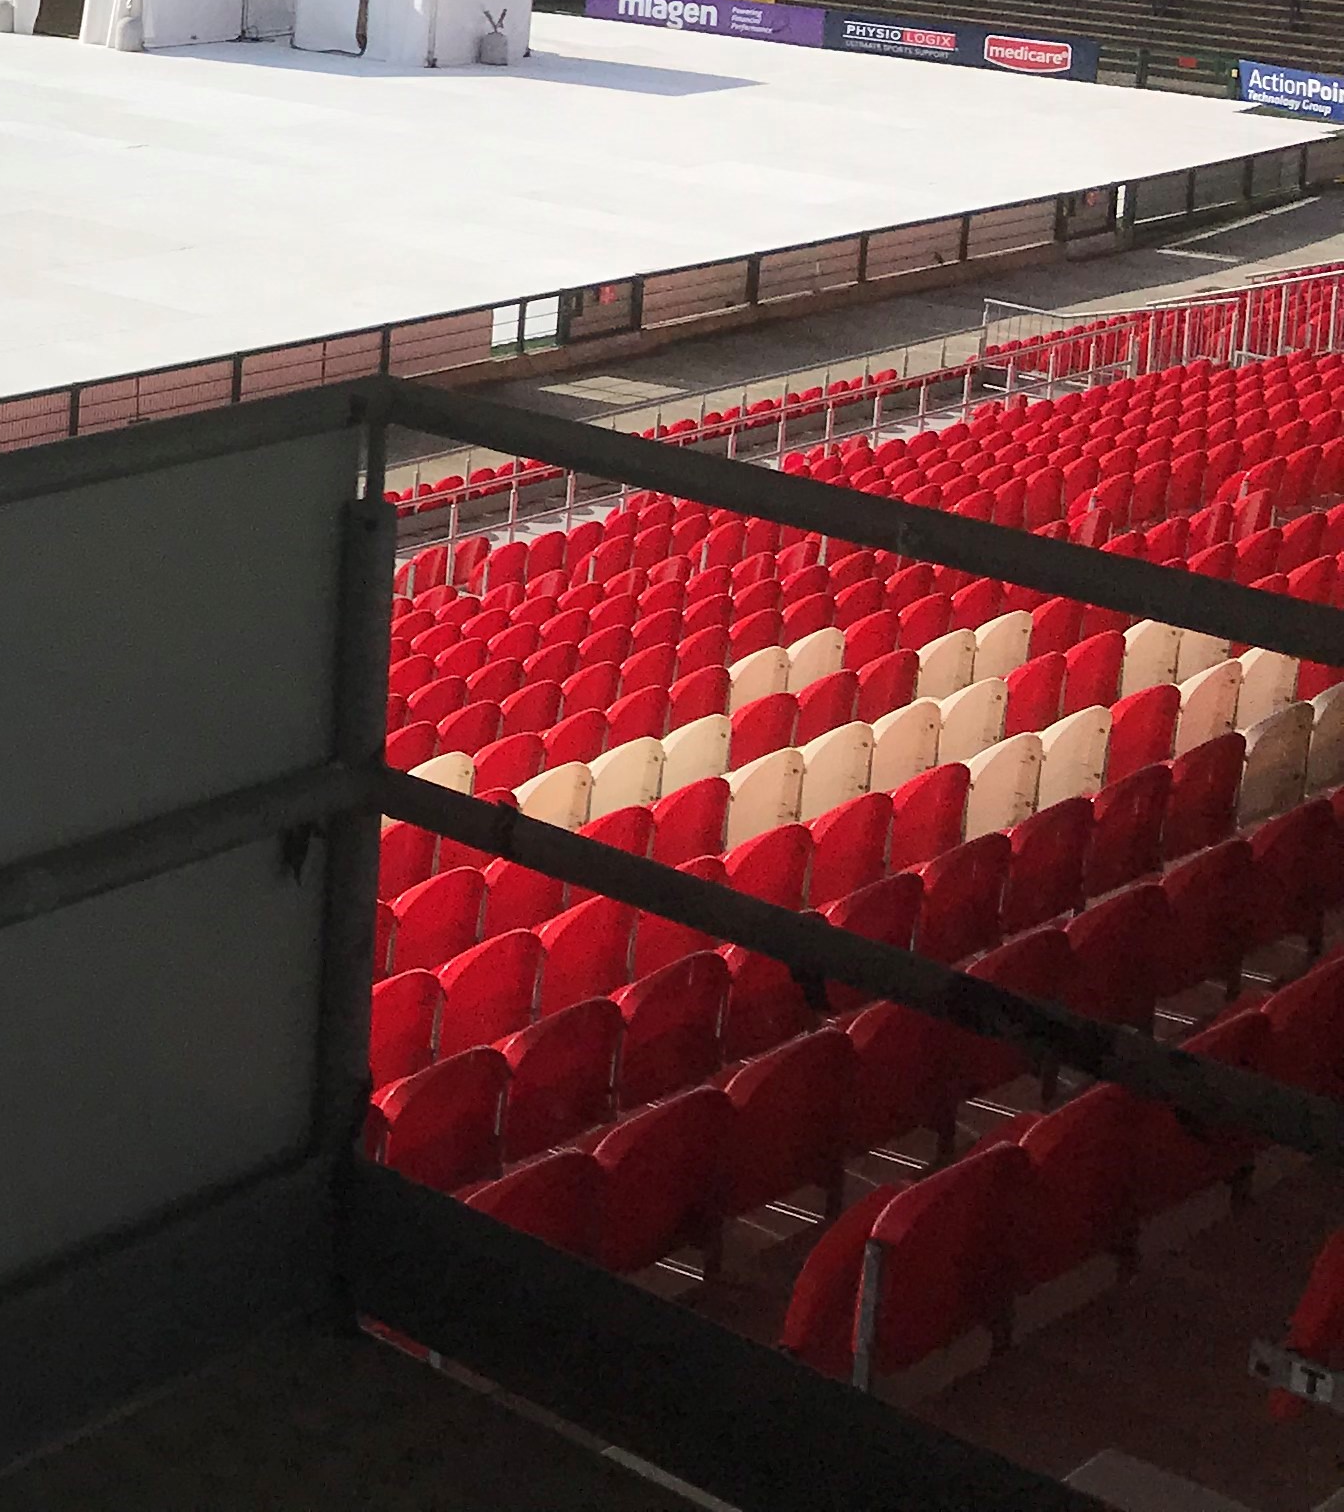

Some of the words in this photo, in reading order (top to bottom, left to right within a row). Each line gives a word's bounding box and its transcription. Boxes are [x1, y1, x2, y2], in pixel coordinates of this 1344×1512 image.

[846, 24, 901, 40] PHYSIO
[907, 33, 952, 47] LOGIX
[1247, 89, 1301, 111] Technology
[1302, 99, 1332, 117] Group
